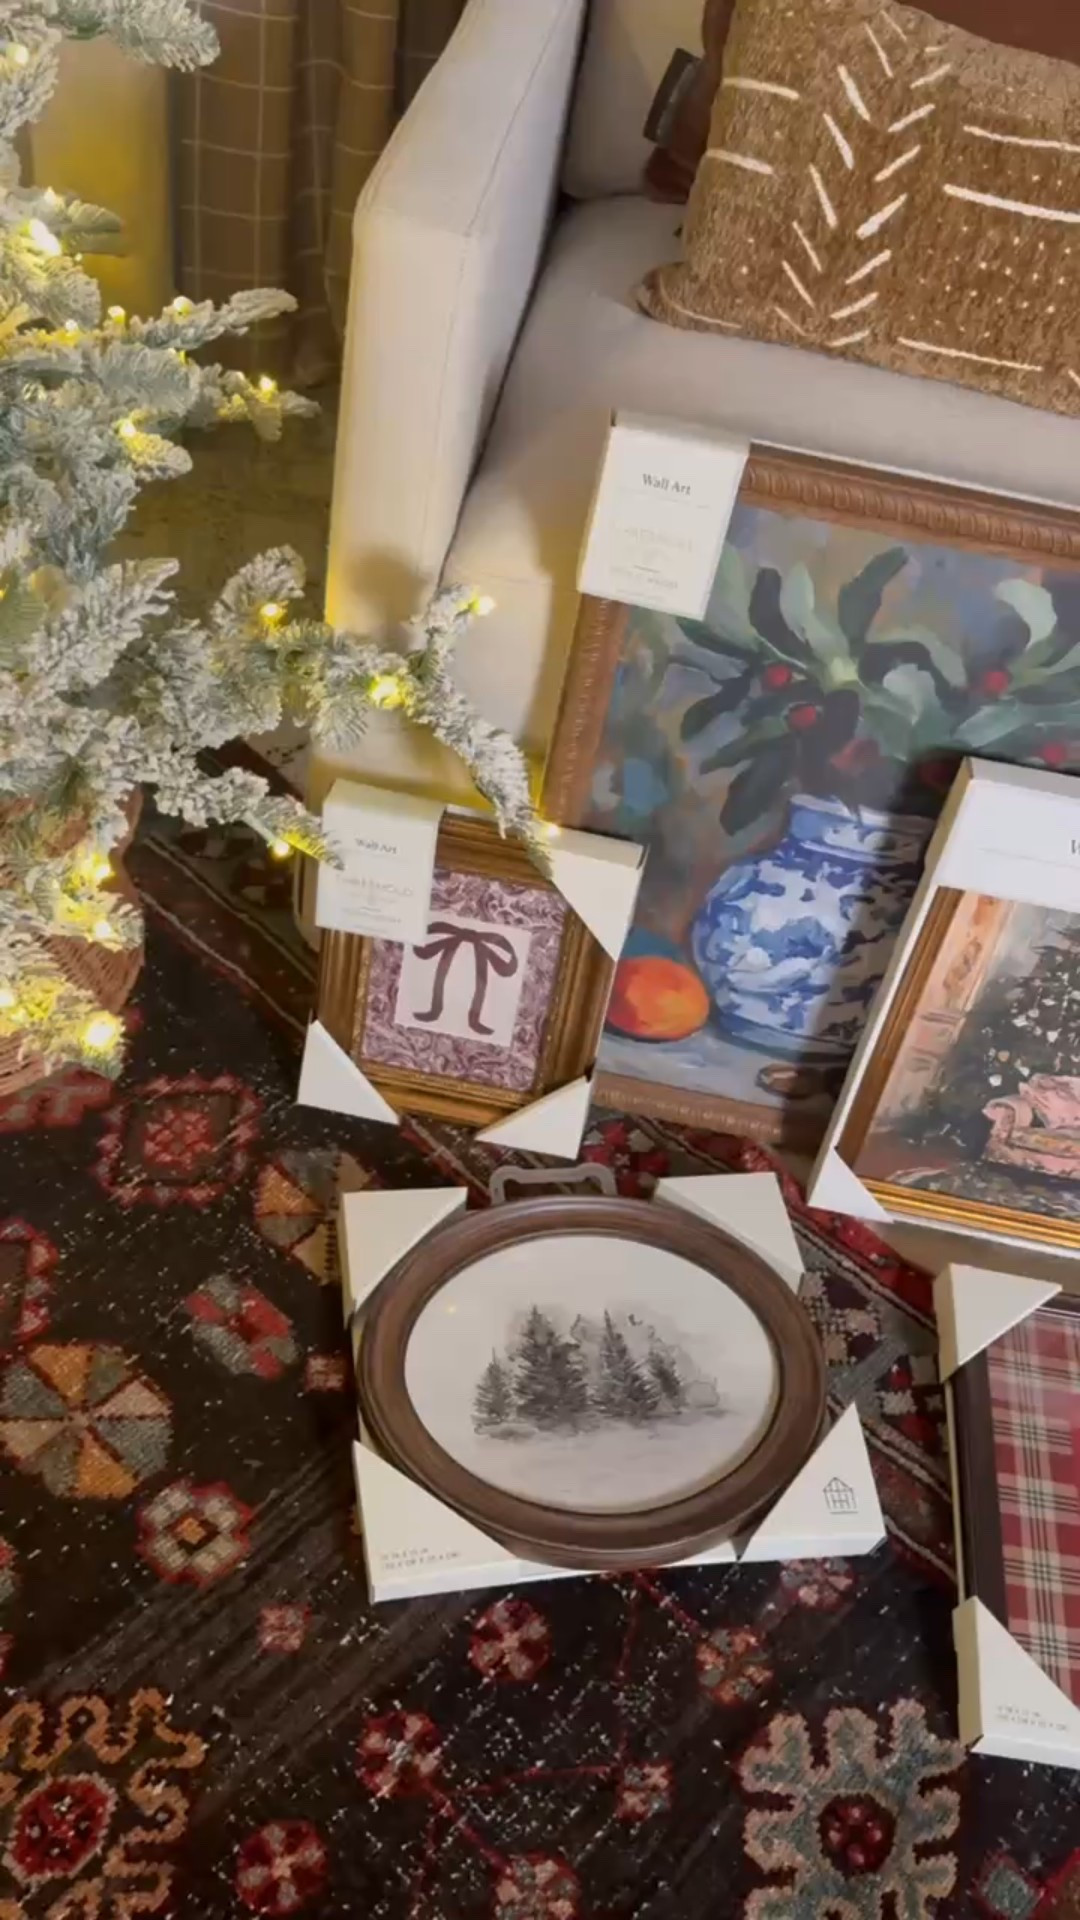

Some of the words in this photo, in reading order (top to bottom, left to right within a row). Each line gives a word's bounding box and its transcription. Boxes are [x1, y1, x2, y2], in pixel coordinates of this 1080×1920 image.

[642, 473, 669, 491] Wall
[671, 480, 692, 497] Art
[355, 838, 379, 850] Wall
[380, 843, 398, 855] Art
